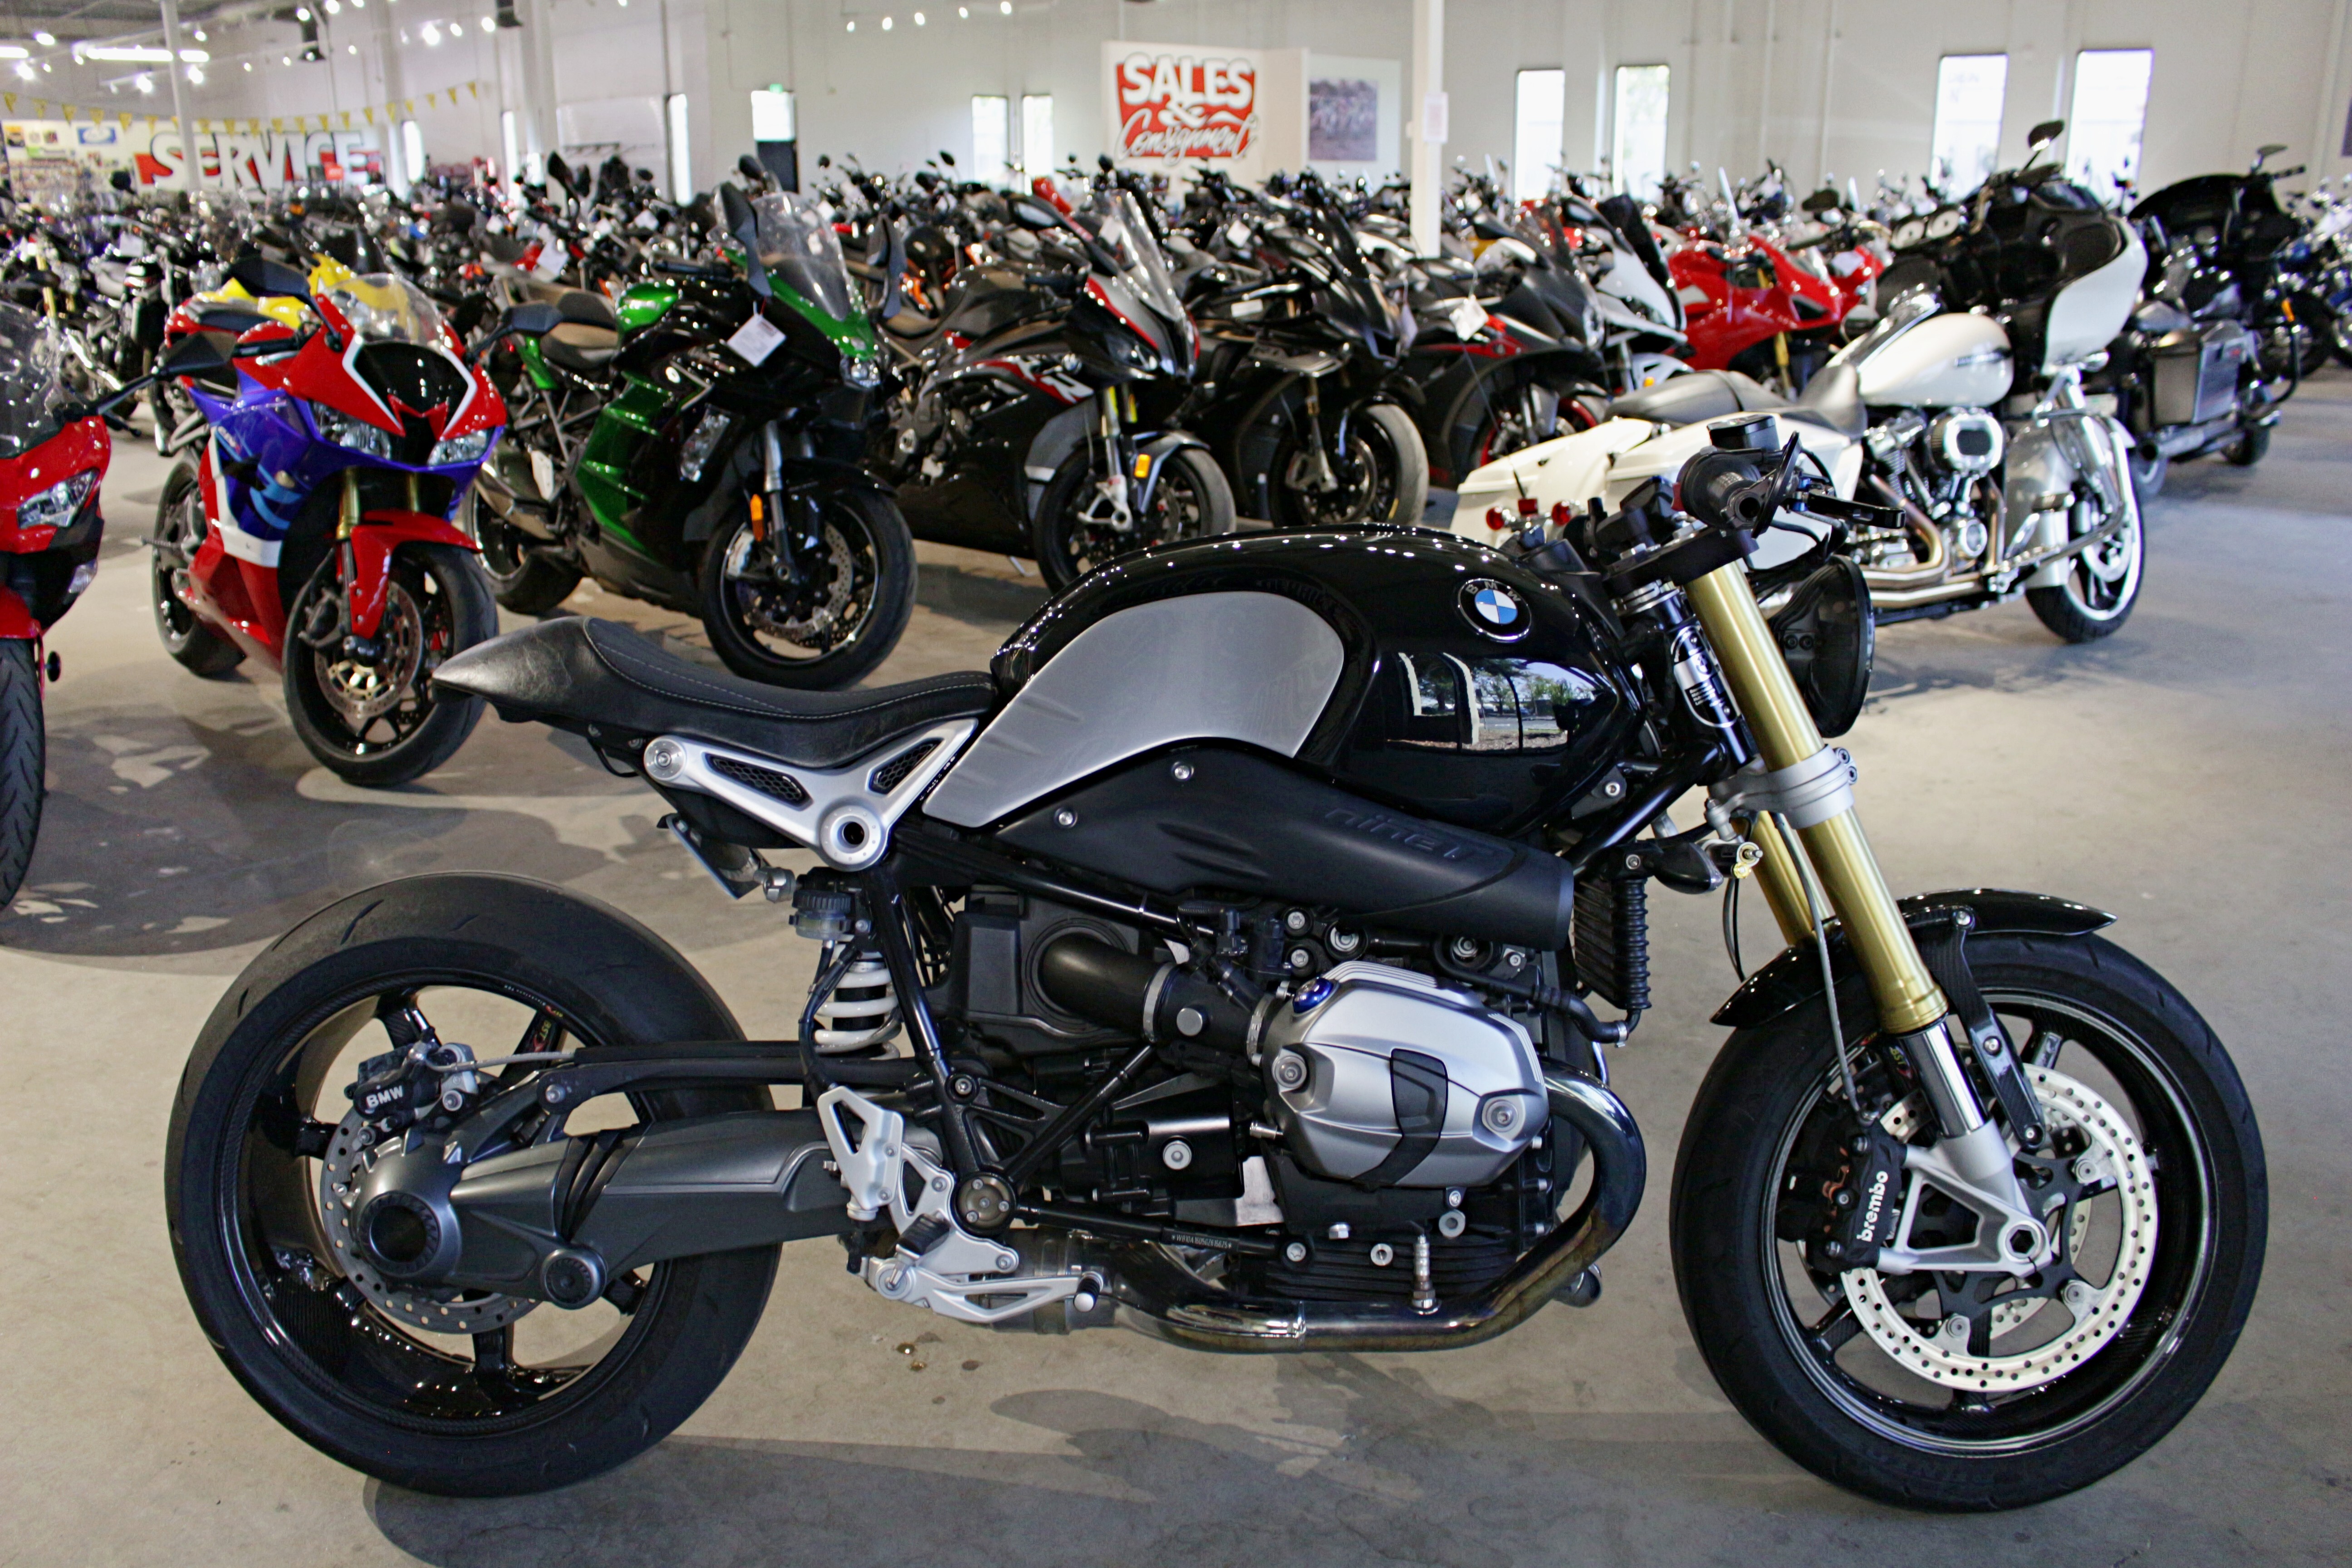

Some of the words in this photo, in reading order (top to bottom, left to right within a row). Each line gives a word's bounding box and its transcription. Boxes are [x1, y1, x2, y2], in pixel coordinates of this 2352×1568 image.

[1122, 51, 1253, 110] SALES
[150, 132, 369, 194] SERVICE
[1115, 108, 1259, 166] Consignment
[1465, 581, 1521, 602] BMW
[366, 1085, 403, 1108] BMW
[1856, 1171, 1889, 1242] brembo
